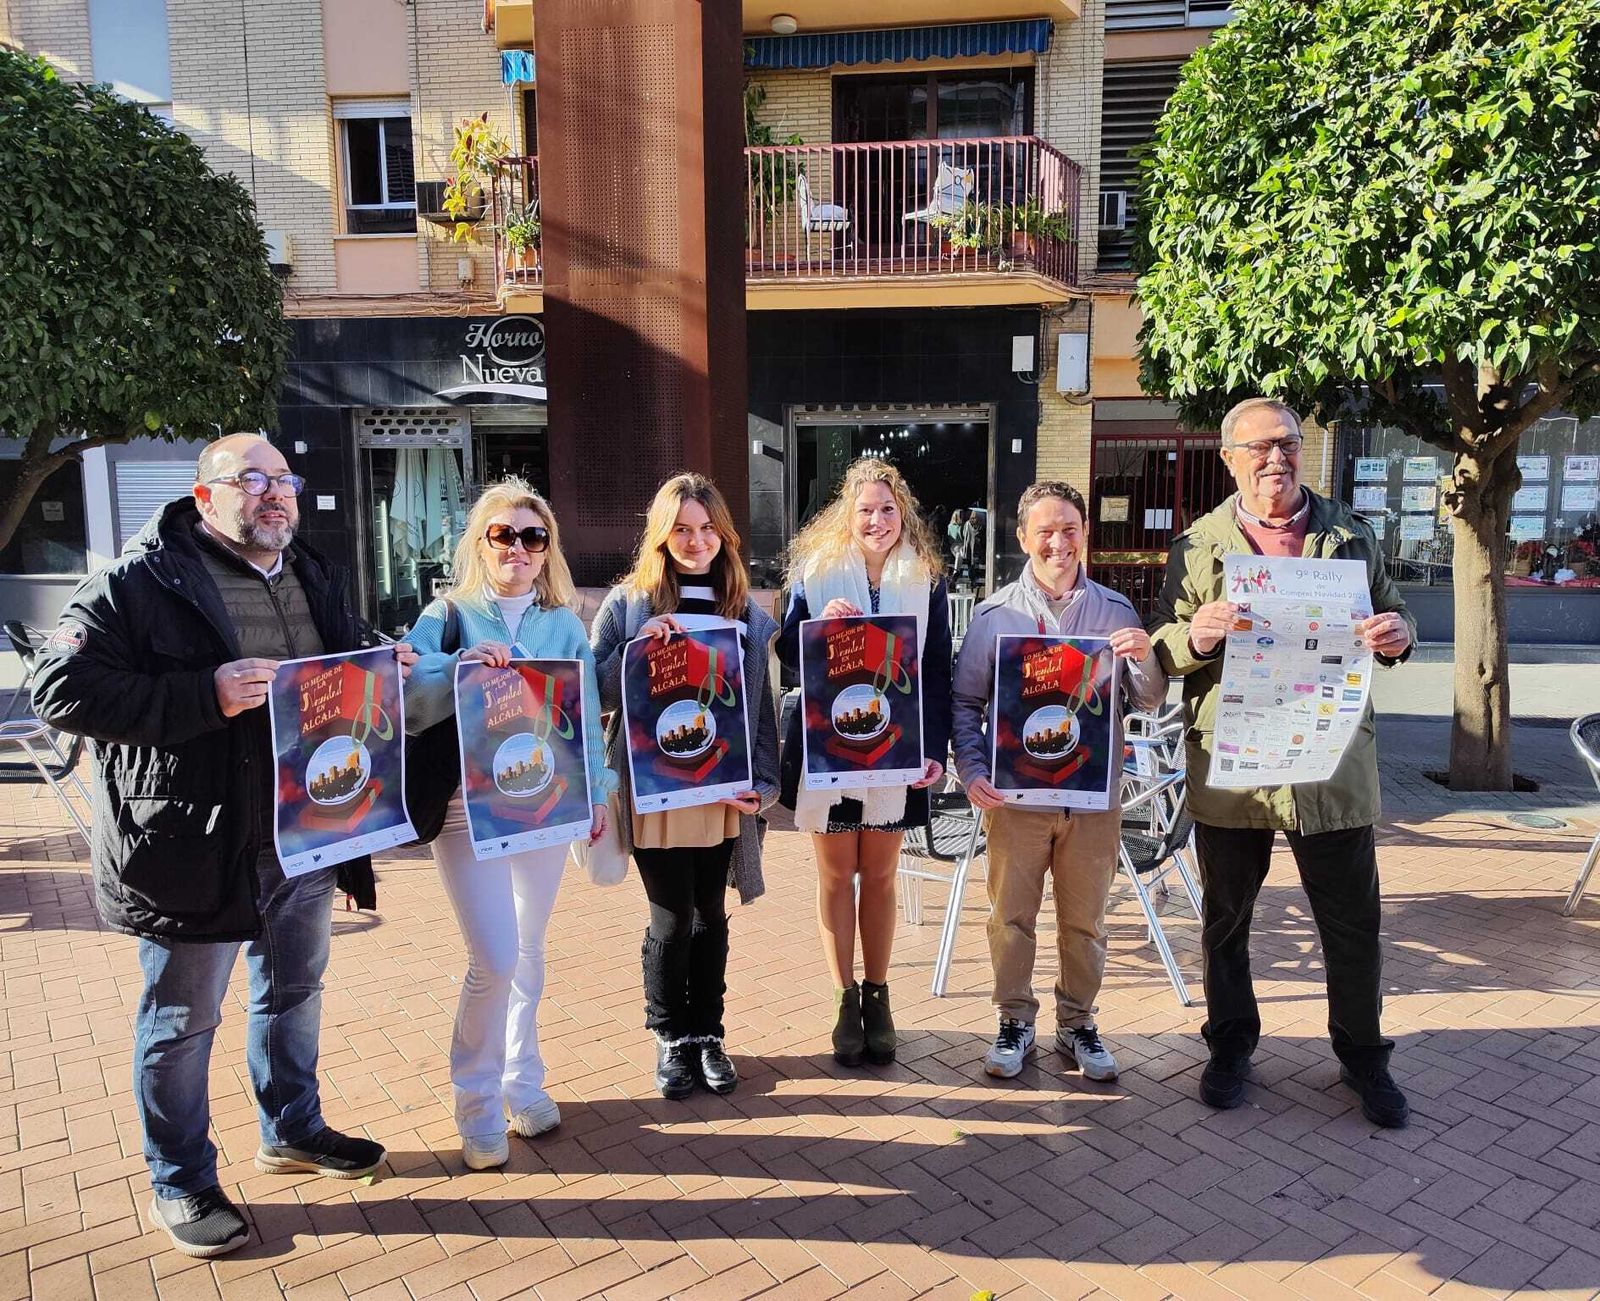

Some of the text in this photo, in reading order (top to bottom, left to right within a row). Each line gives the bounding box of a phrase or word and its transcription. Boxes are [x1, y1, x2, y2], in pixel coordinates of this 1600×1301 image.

[465, 324, 542, 348] Horno
[459, 354, 544, 384] Nueva
[1312, 570, 1343, 583] Rally
[836, 628, 856, 640] MEJOR
[857, 624, 865, 632] DE
[648, 652, 656, 660] LO
[657, 643, 677, 656] MEJOR
[1032, 647, 1053, 659] MEJOR
[301, 665, 343, 692] LO MEJOR DE
[317, 681, 326, 689] LA
